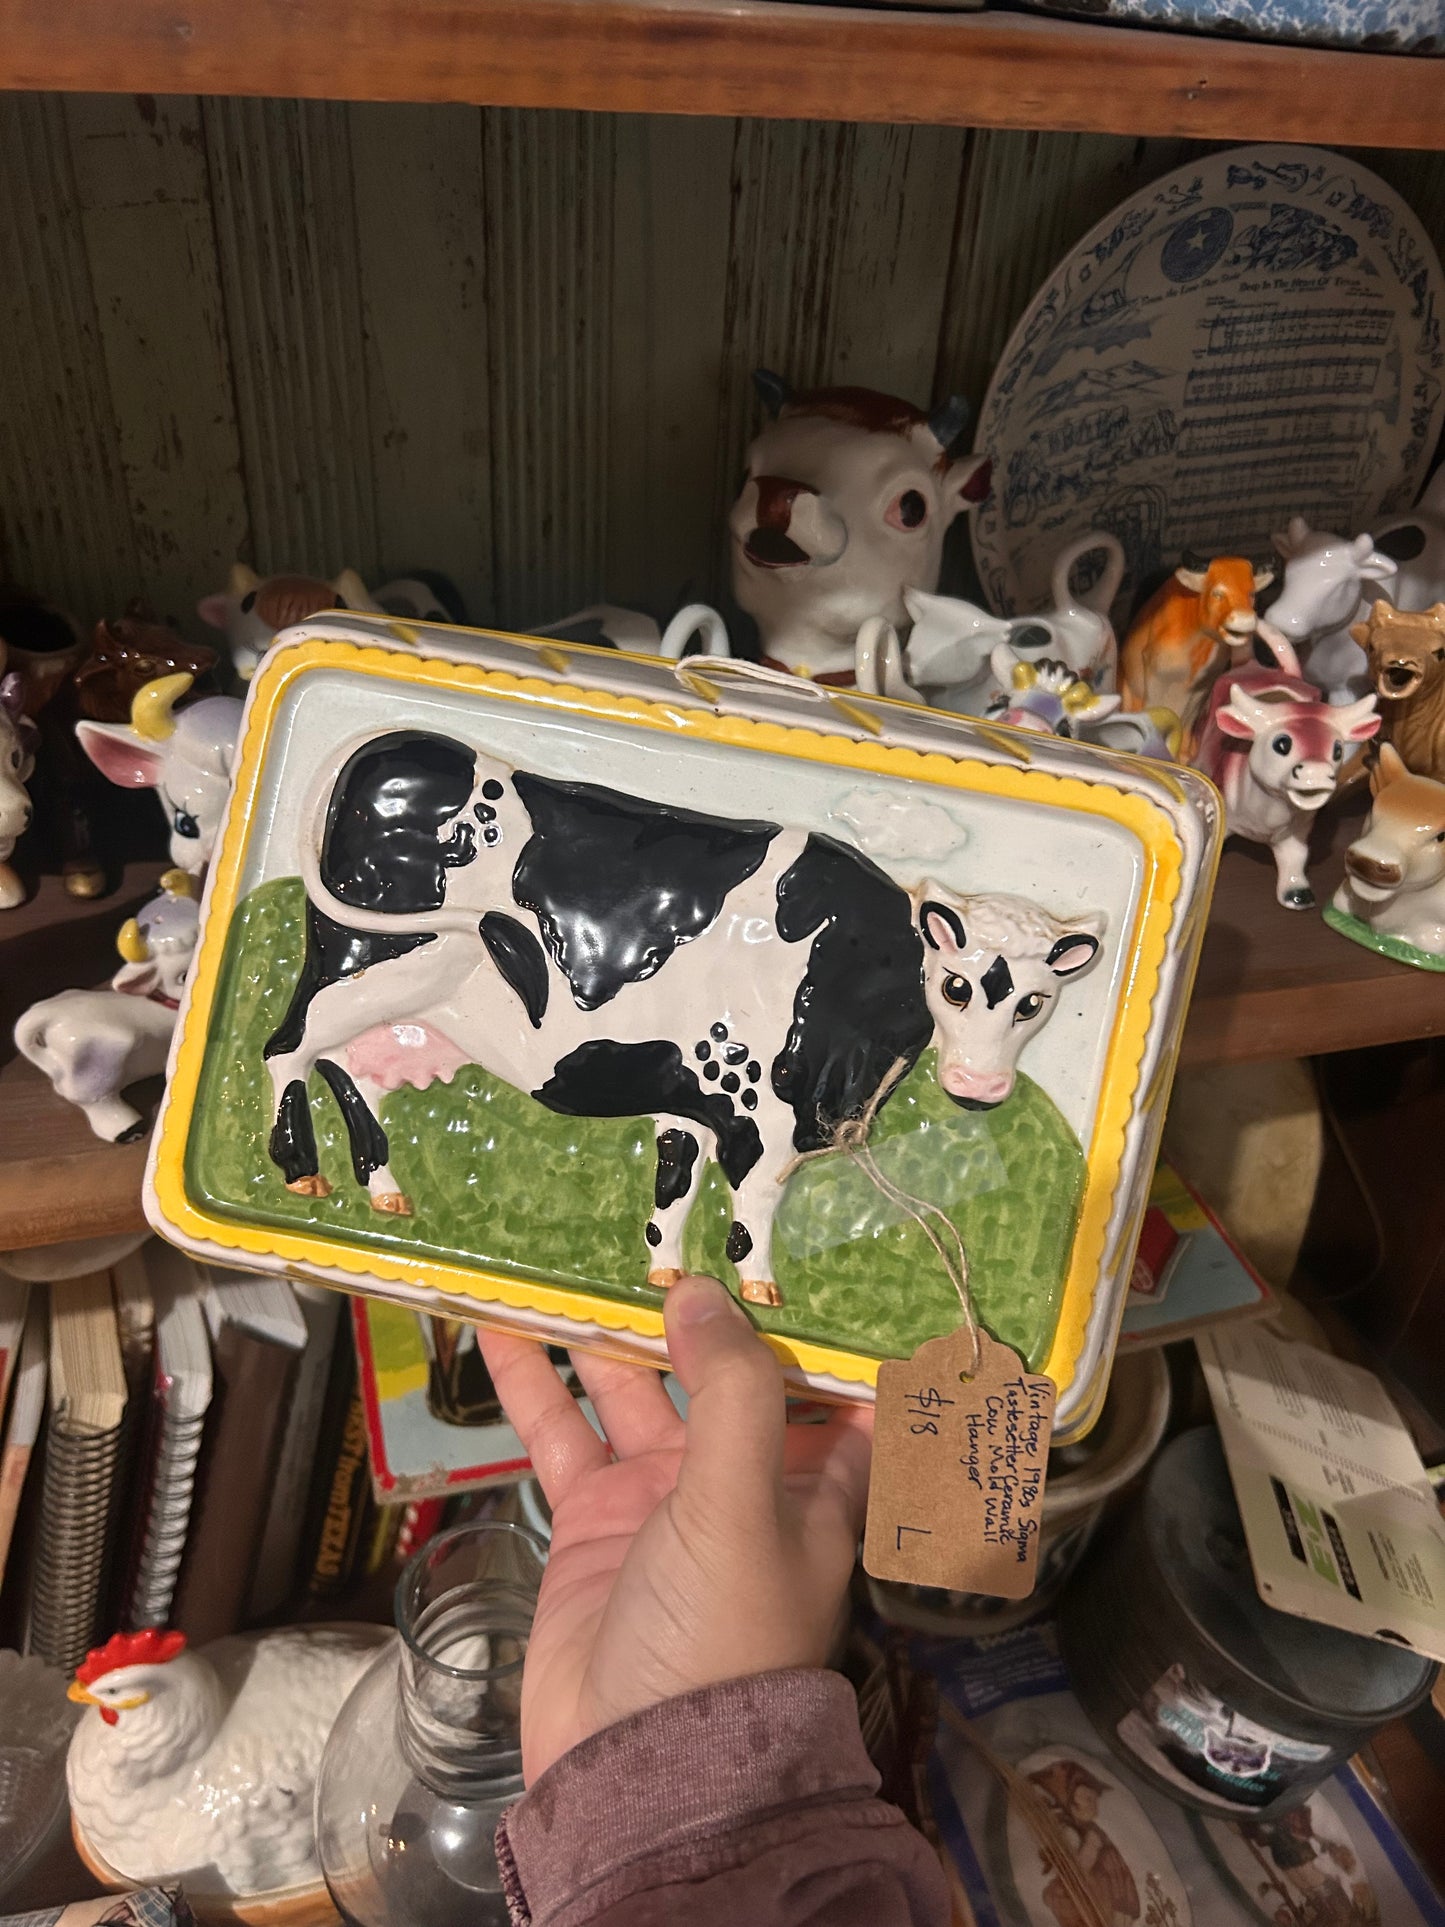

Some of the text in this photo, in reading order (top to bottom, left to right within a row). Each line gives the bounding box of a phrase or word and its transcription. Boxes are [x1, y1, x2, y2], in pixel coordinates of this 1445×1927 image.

[1239, 281, 1259, 292] Deep
[1273, 279, 1289, 289] The
[904, 1387, 955, 1437] $18
[959, 1413, 983, 1491] Hanger
[999, 1376, 1028, 1545] Tastesetter Ceramic
[984, 1396, 1005, 1542] Cow Mold Wall
[1008, 1382, 1051, 1562] Vintage 1980s Sigma
